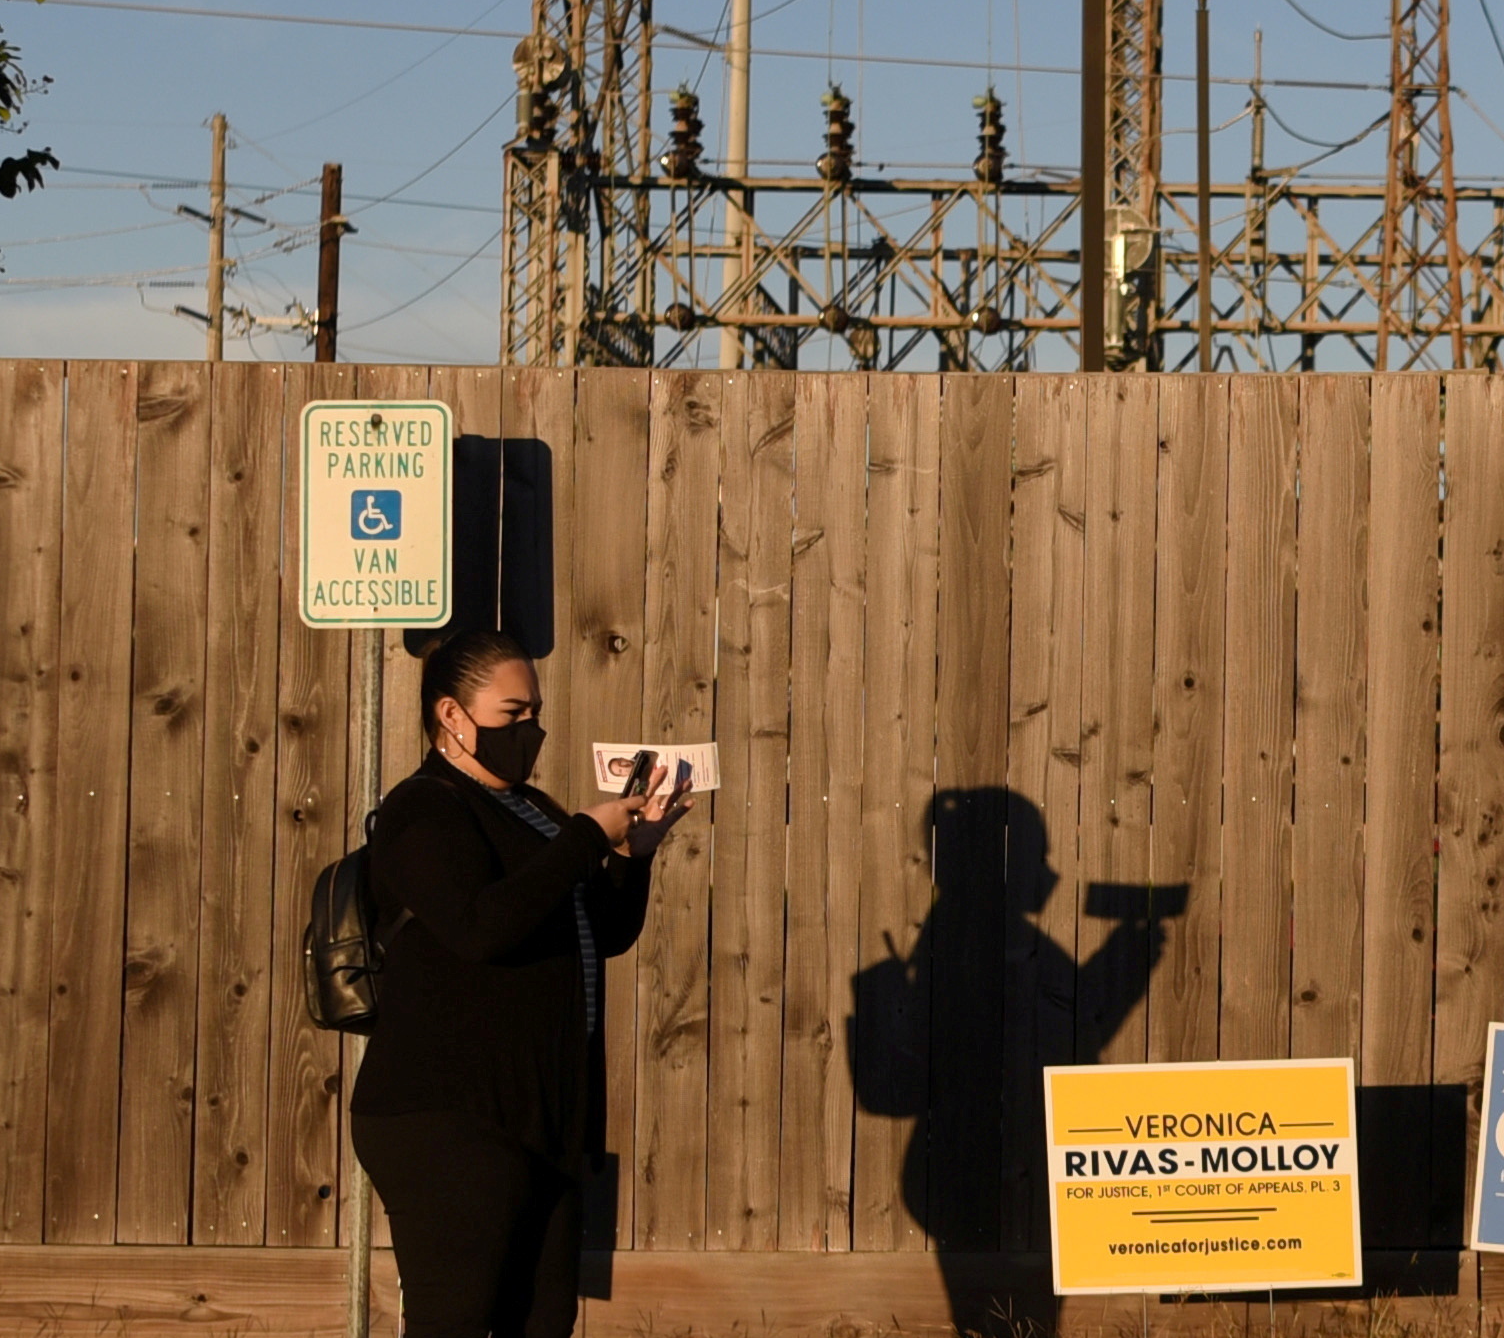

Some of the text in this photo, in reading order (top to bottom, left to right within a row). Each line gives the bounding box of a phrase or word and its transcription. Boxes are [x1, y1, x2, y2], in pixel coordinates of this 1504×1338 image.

[320, 421, 432, 447] RESERVED
[327, 452, 424, 478] PARKING
[354, 548, 397, 574] VAN
[313, 580, 437, 606] ACCESSIBLE
[1125, 1112, 1277, 1139] VERONICA
[1067, 1187, 1093, 1199] FOR
[1097, 1185, 1152, 1199] JUSTICE,
[1175, 1183, 1221, 1196] COURT
[1226, 1182, 1244, 1195] OF
[1311, 1180, 1330, 1193] PL.
[1333, 1180, 1341, 1192] 3
[1109, 1237, 1302, 1256] veronicaforjustice.com
